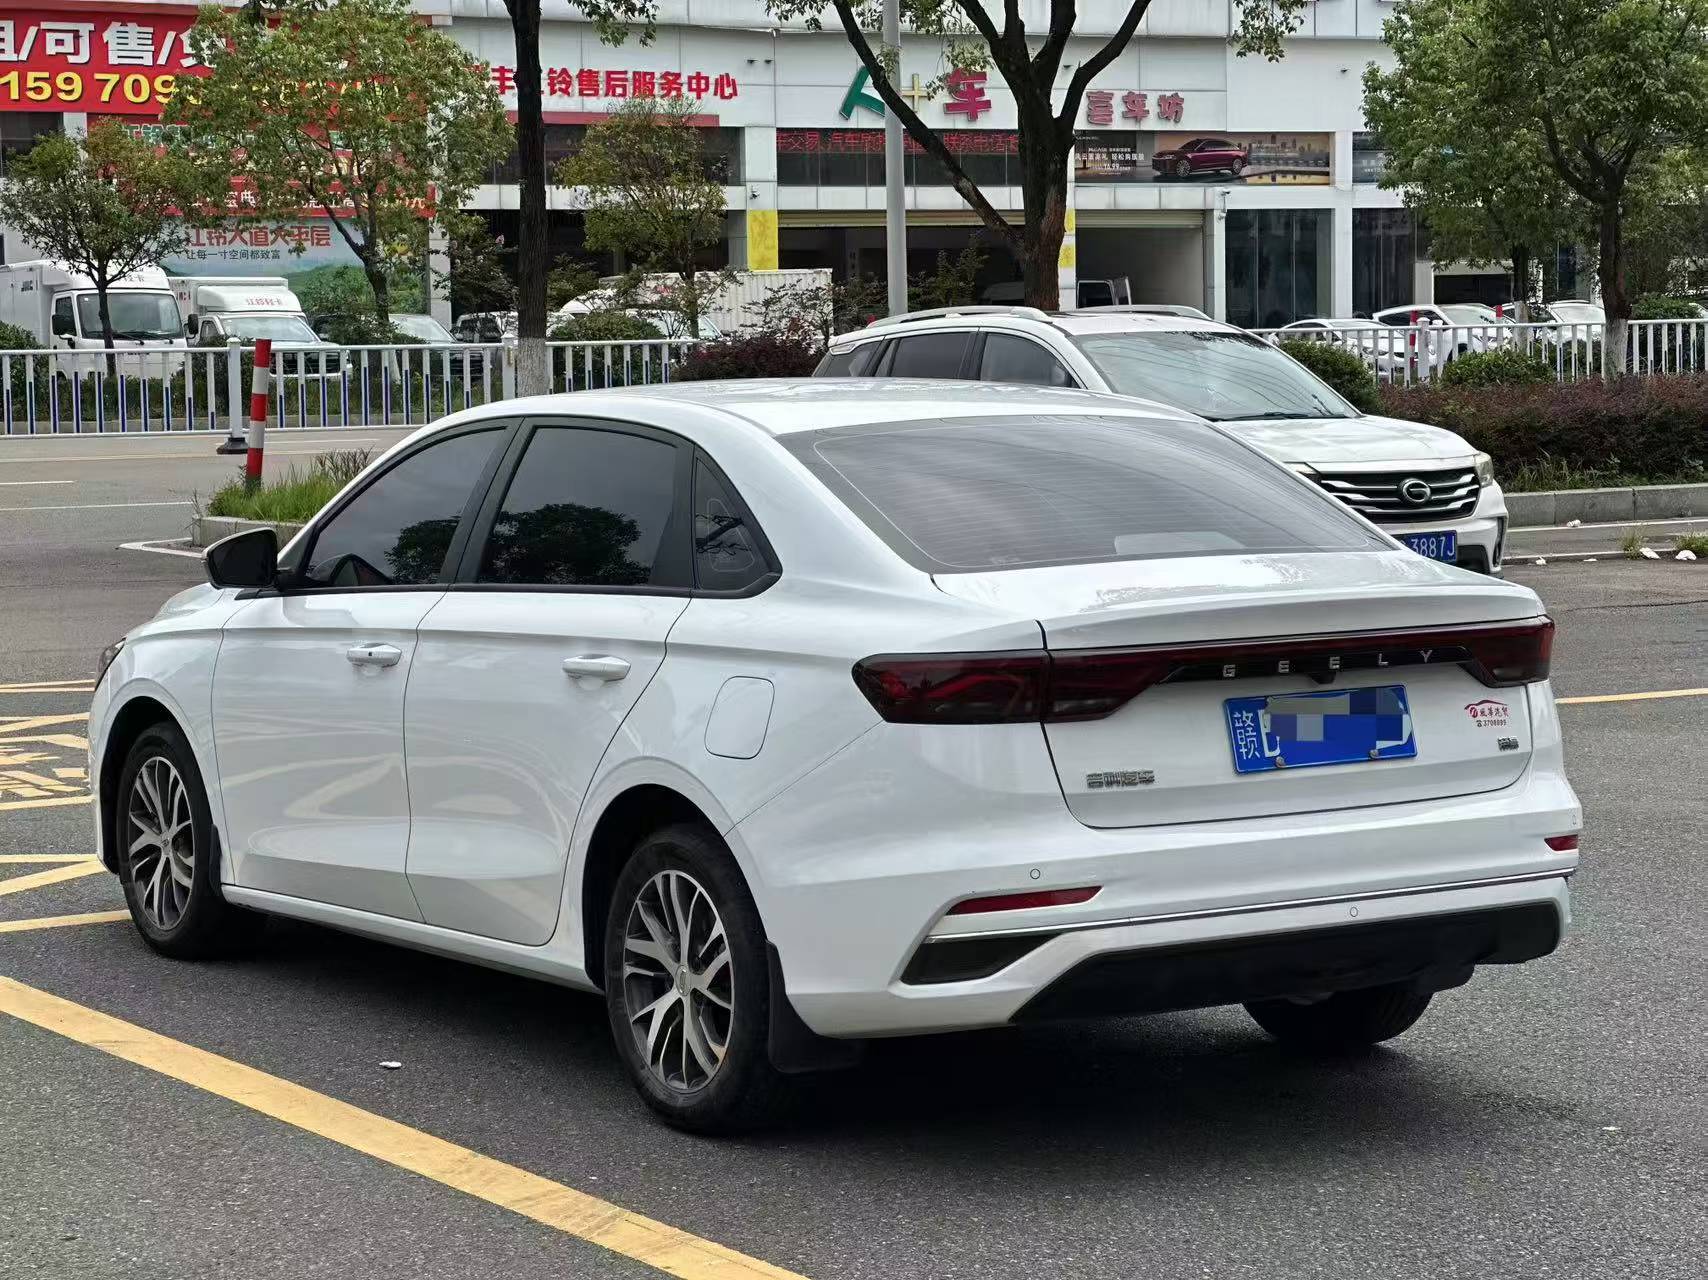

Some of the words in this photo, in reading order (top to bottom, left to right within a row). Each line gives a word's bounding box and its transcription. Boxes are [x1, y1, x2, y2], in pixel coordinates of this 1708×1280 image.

[0, 71, 83, 101] 159
[93, 73, 202, 105] 709
[491, 65, 738, 100] 丰铃售后服务中心
[1222, 650, 1433, 678] GEELY
